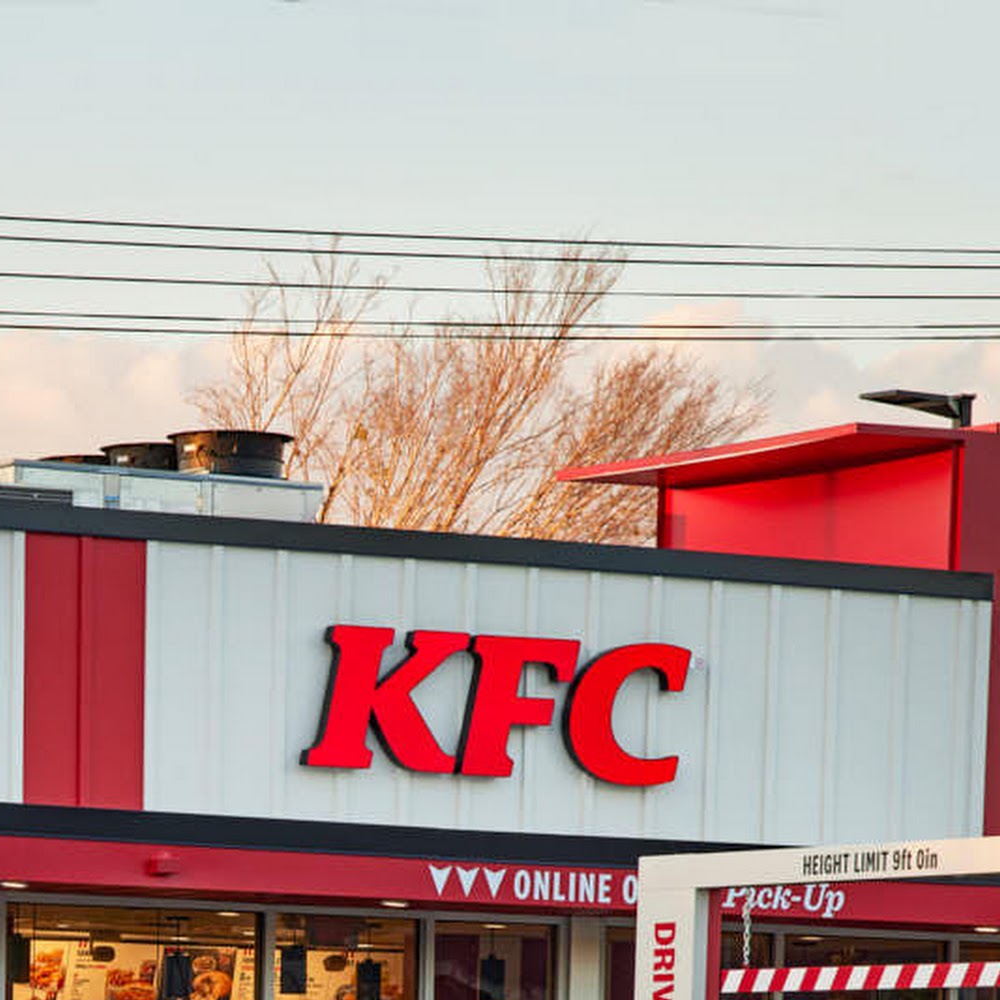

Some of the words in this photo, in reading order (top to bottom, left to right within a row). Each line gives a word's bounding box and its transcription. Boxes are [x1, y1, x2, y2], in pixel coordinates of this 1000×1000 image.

[300, 624, 692, 786] KFC
[803, 854, 849, 875] HEIGHT
[853, 852, 889, 873] LIMIT
[893, 849, 912, 870] 9ft
[514, 869, 611, 904] ONLINE
